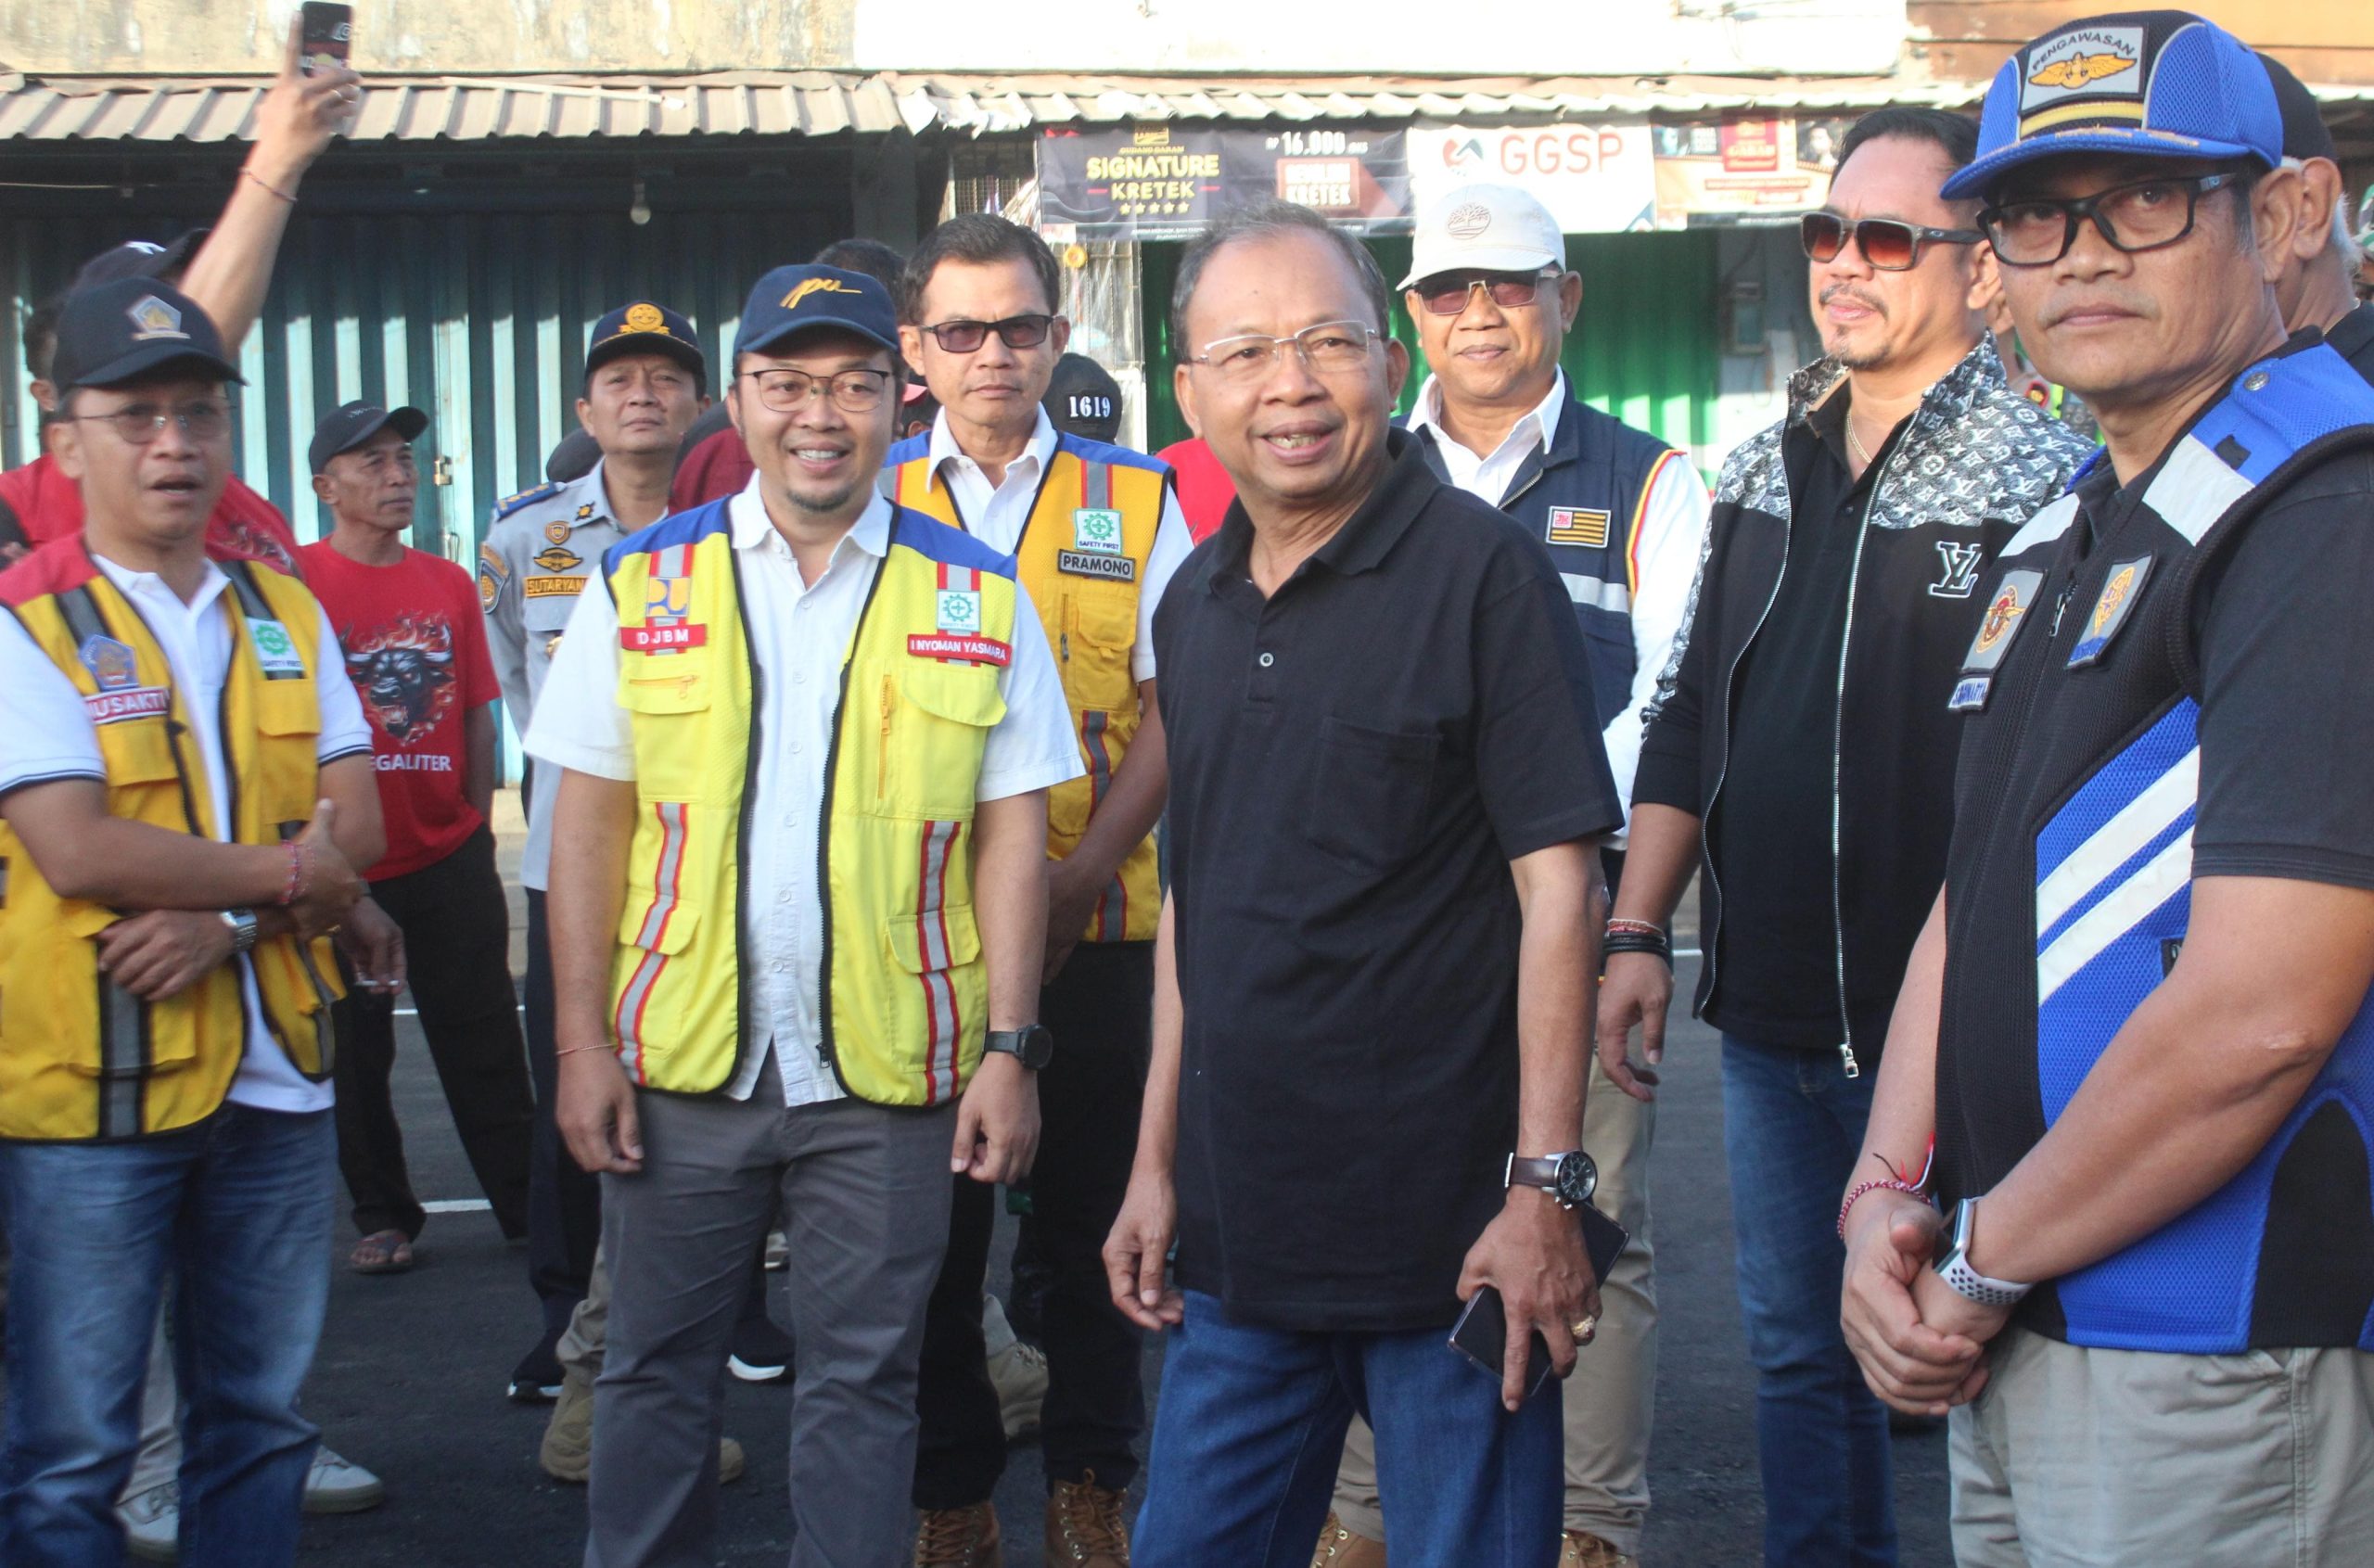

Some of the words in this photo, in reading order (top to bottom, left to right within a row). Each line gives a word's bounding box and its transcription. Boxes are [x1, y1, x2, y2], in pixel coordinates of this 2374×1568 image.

[2032, 32, 2135, 70] PENGAWASAN
[1500, 133, 1623, 175] GGSP
[1086, 154, 1220, 180] SIGNATURE
[1111, 181, 1196, 200] KRETEK
[1069, 396, 1110, 417] 1619
[1063, 555, 1130, 575] PRAMONO
[916, 640, 962, 652] NYOMAN
[963, 641, 1007, 660] YASMARA
